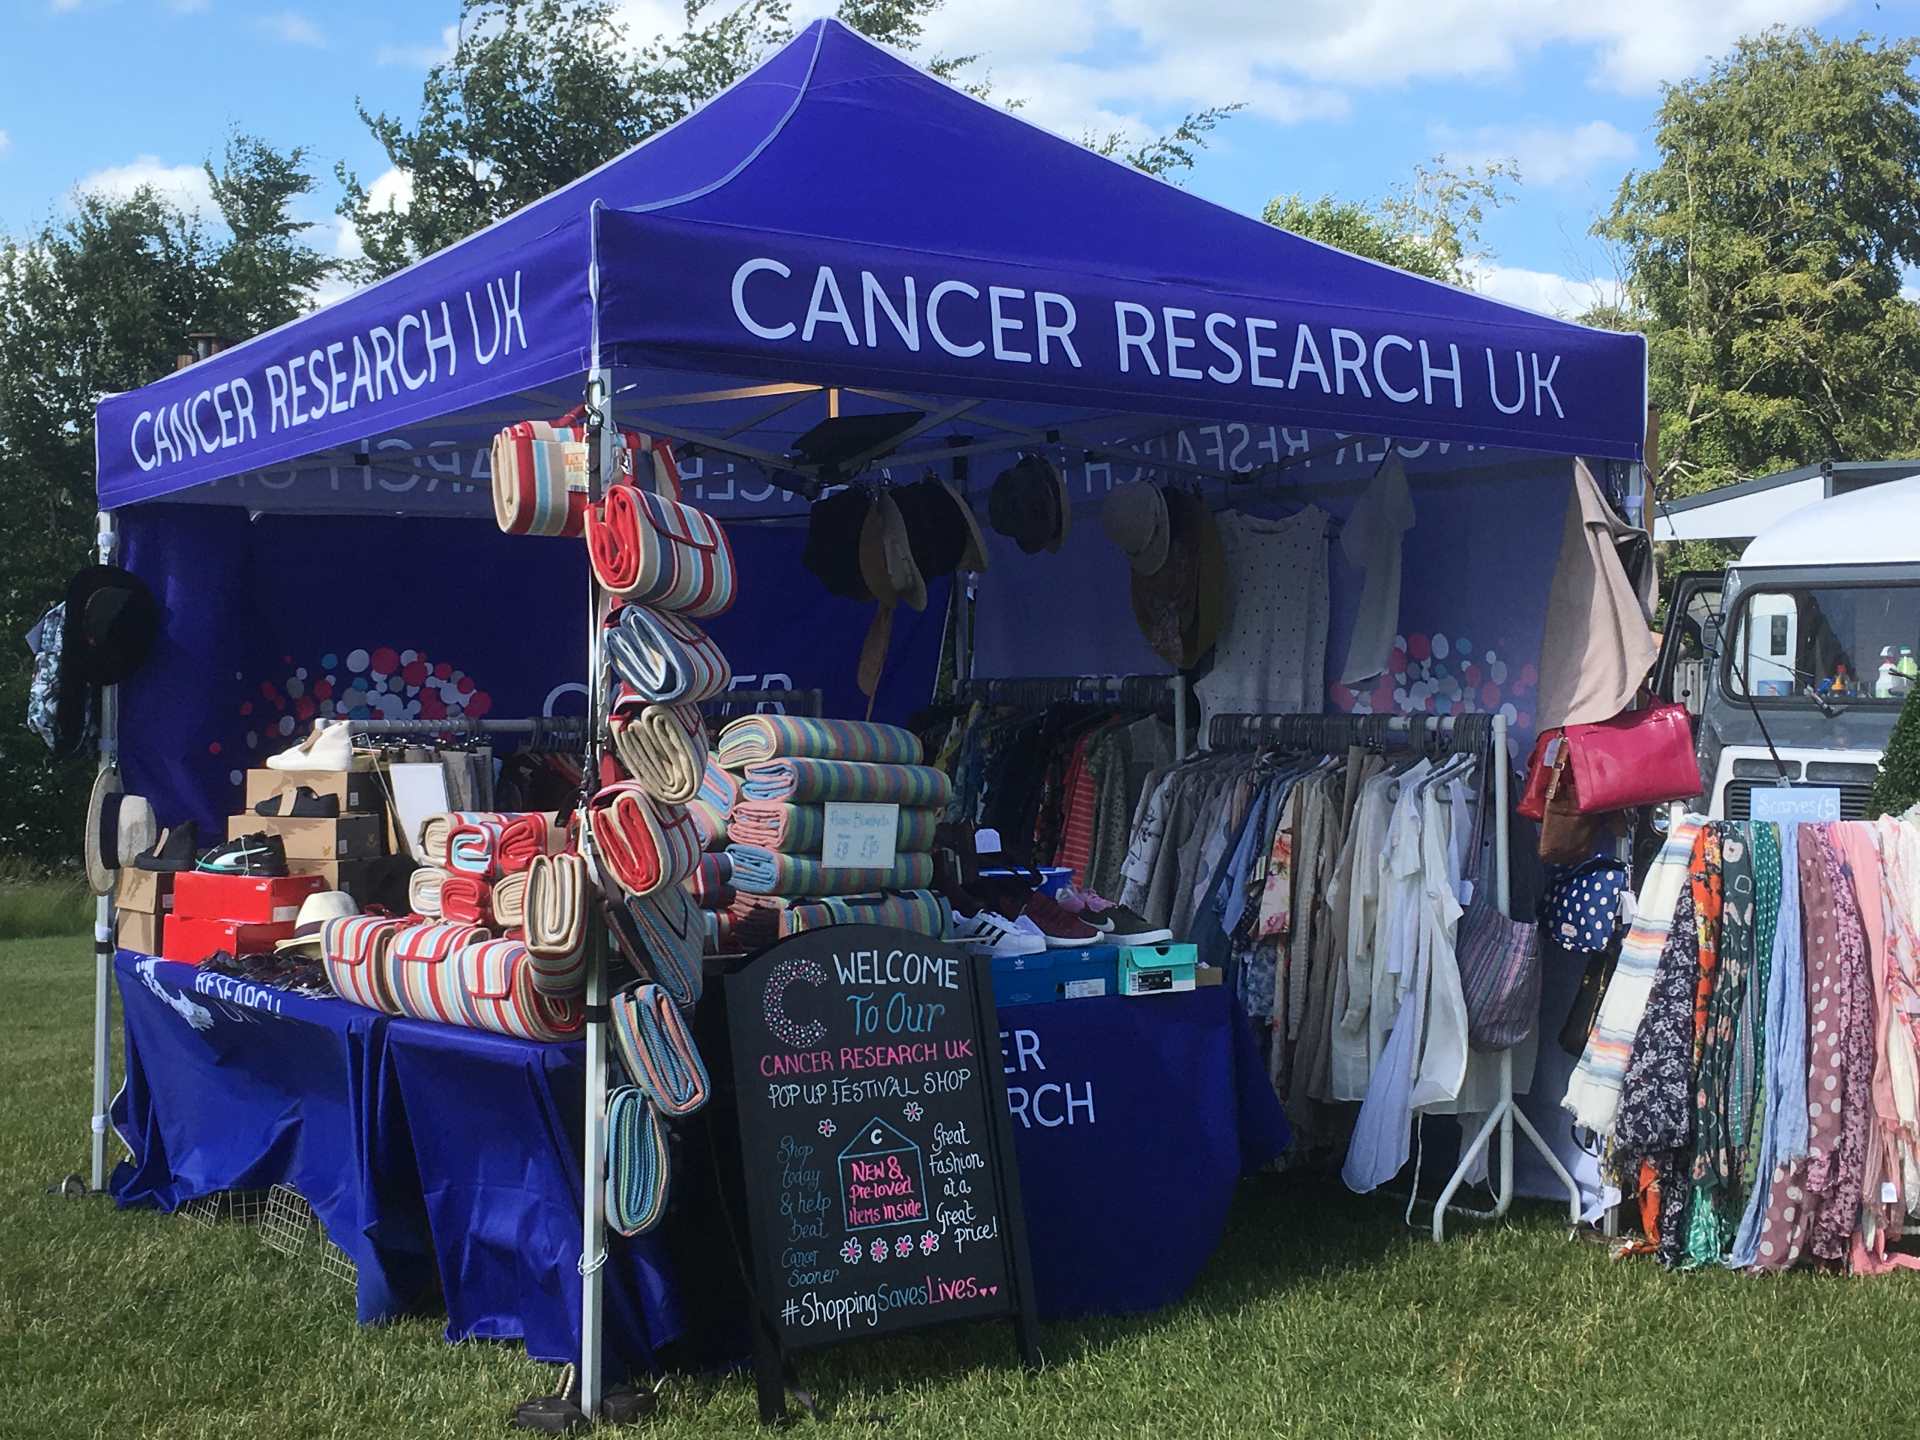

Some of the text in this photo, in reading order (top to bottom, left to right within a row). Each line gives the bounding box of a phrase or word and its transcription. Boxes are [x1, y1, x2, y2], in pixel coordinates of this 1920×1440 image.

[731, 258, 1565, 420] CANCER RESEARCH UK
[130, 269, 528, 471] CANCER RESEARCH UK
[832, 950, 960, 990] WELCOME
[846, 992, 946, 1036] To Our
[760, 1039, 974, 1077] CANCER RESEARCH UK
[831, 1076, 920, 1105] FESTIVAL
[923, 1068, 972, 1094] SHOP
[776, 1135, 815, 1165] Shop
[931, 1121, 971, 1153] Great
[782, 1162, 822, 1192] today
[887, 1155, 904, 1180] &
[798, 1191, 832, 1217] help
[943, 1178, 972, 1197] at a
[788, 1217, 830, 1242] beat
[936, 1200, 977, 1235] Great
[954, 1216, 999, 1253] price!
